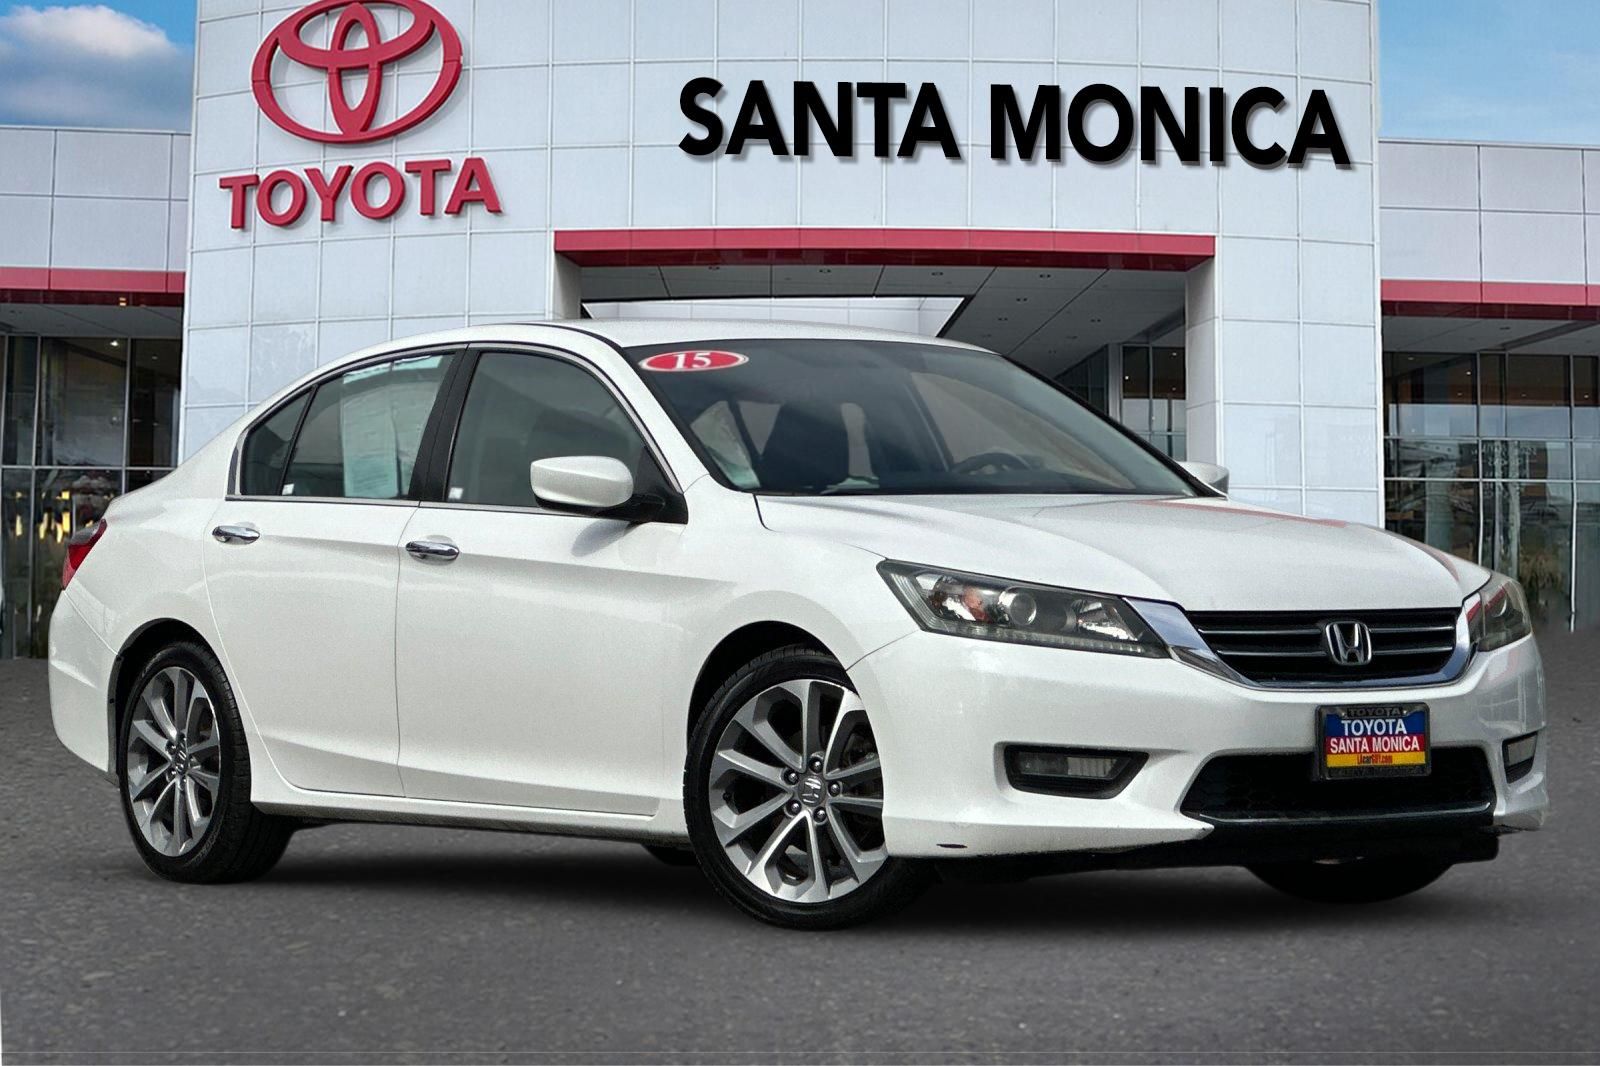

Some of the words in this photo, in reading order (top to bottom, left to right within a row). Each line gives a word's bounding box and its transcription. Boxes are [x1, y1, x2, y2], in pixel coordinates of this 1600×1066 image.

[678, 76, 961, 159] SANTA
[990, 83, 1352, 169] MONICA
[219, 157, 503, 230] TOYOTA
[673, 352, 712, 369] 15
[1348, 707, 1401, 718] TOYOTA
[1341, 718, 1407, 736] TOYOTA
[1330, 737, 1370, 754] SANTA
[1372, 735, 1420, 752] MONICA
